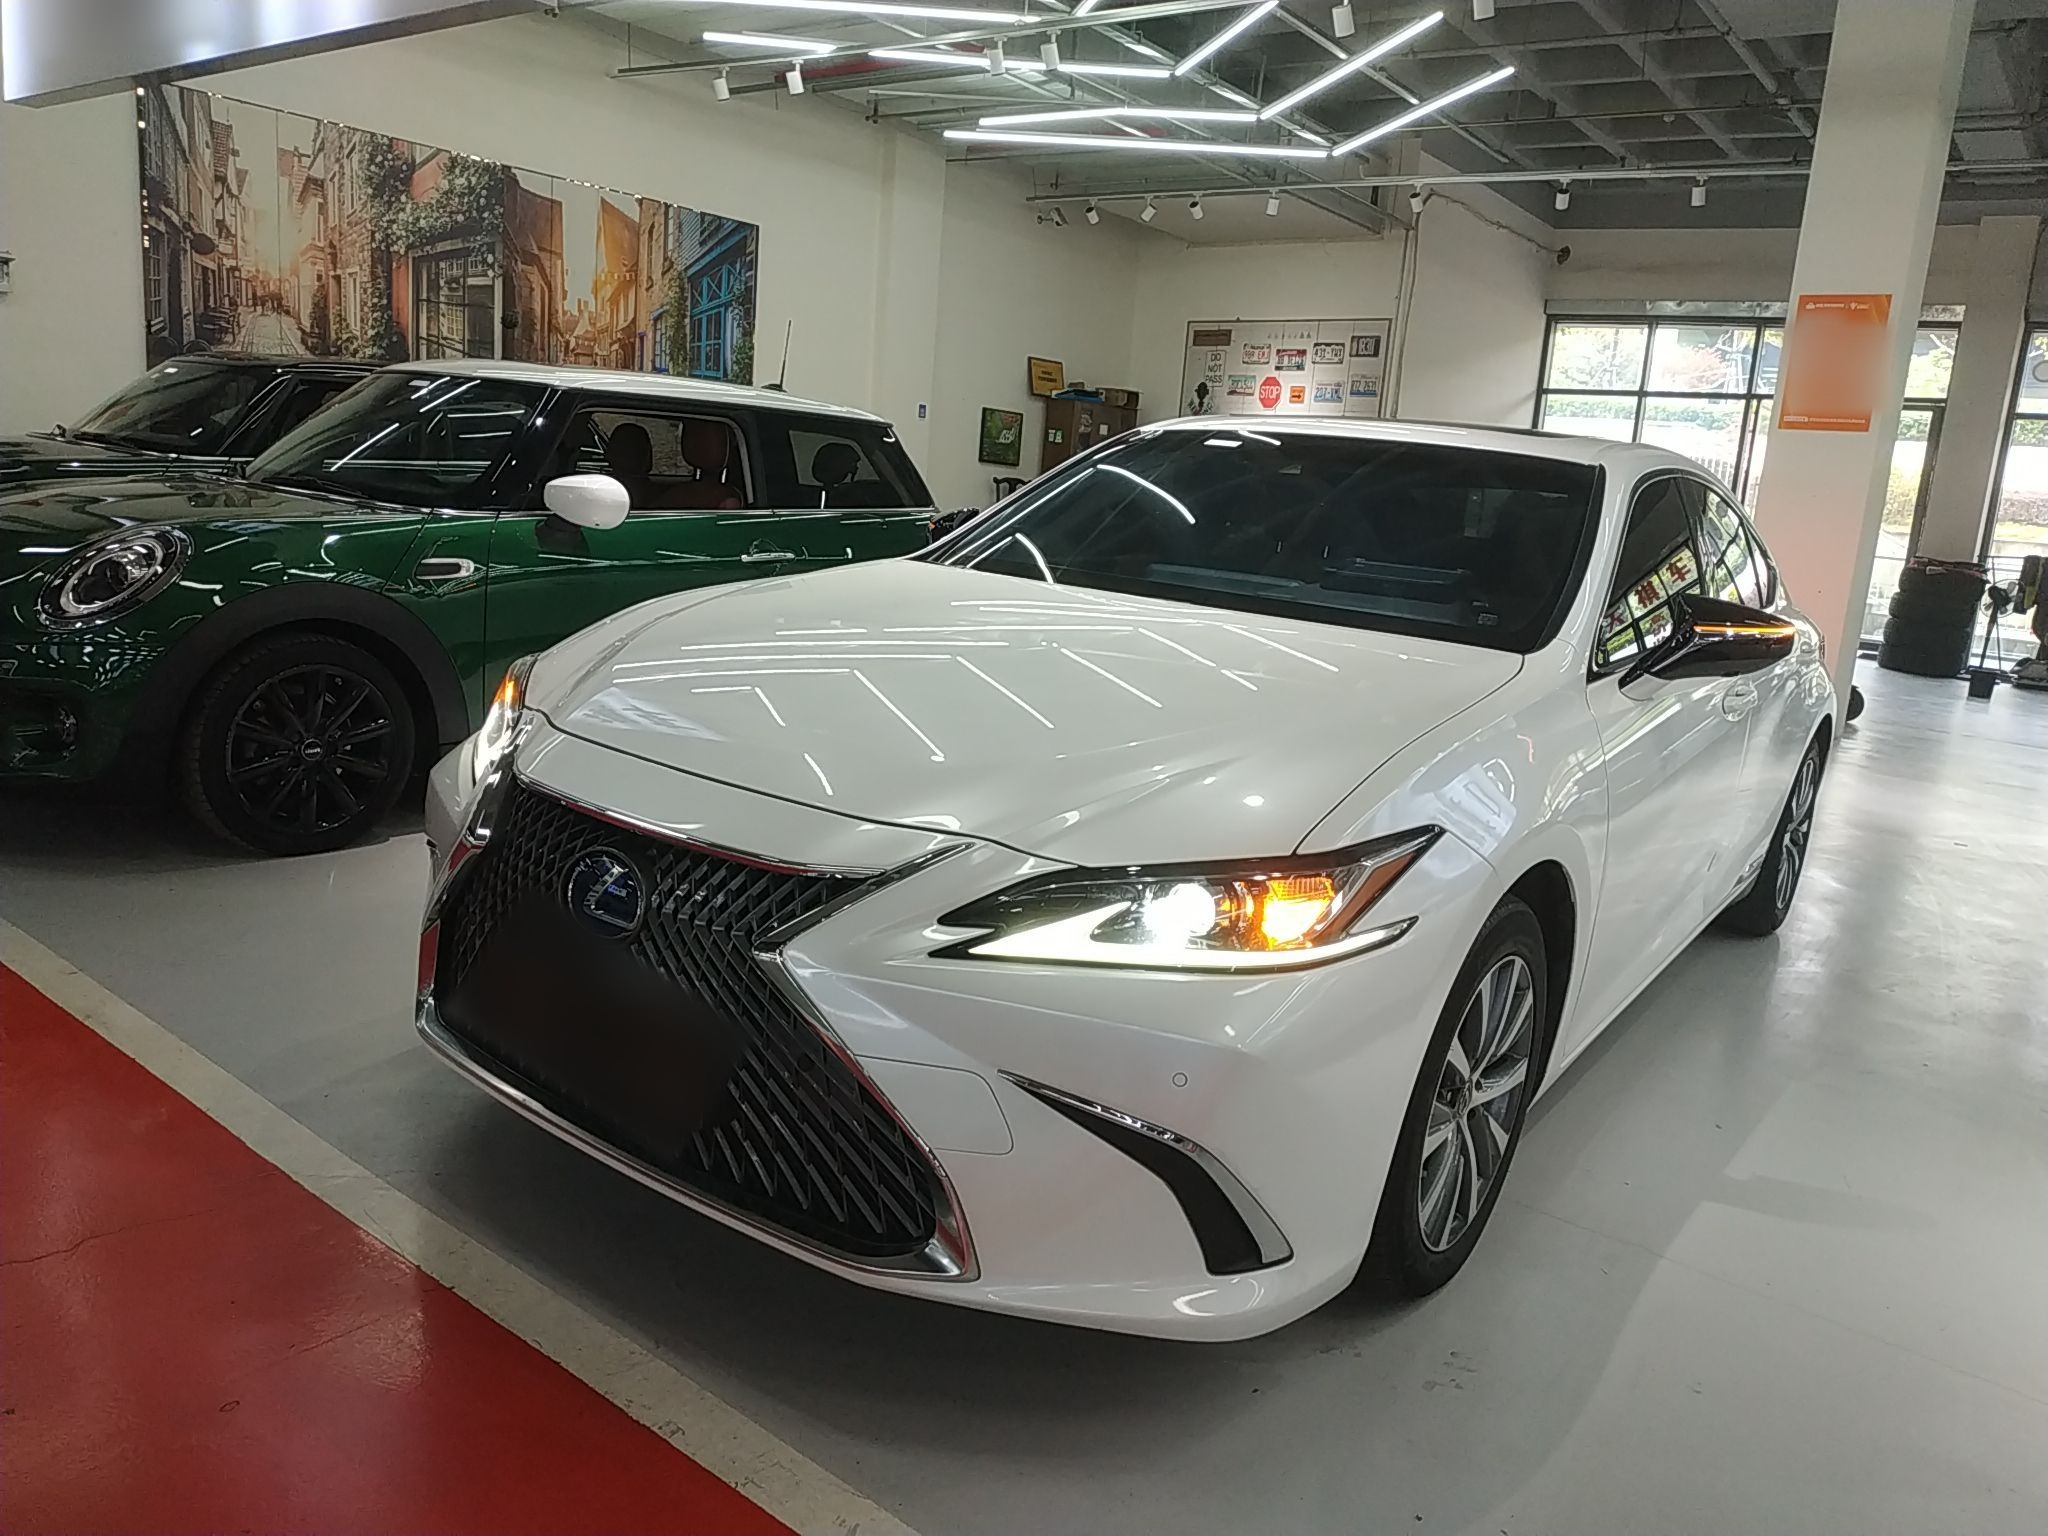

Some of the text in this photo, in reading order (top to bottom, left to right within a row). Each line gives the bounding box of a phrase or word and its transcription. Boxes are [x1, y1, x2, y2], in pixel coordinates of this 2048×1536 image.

[1210, 353, 1222, 362] DO
[1207, 364, 1222, 373] NOT
[1205, 375, 1223, 384] PASS
[1260, 385, 1281, 399] STOP
